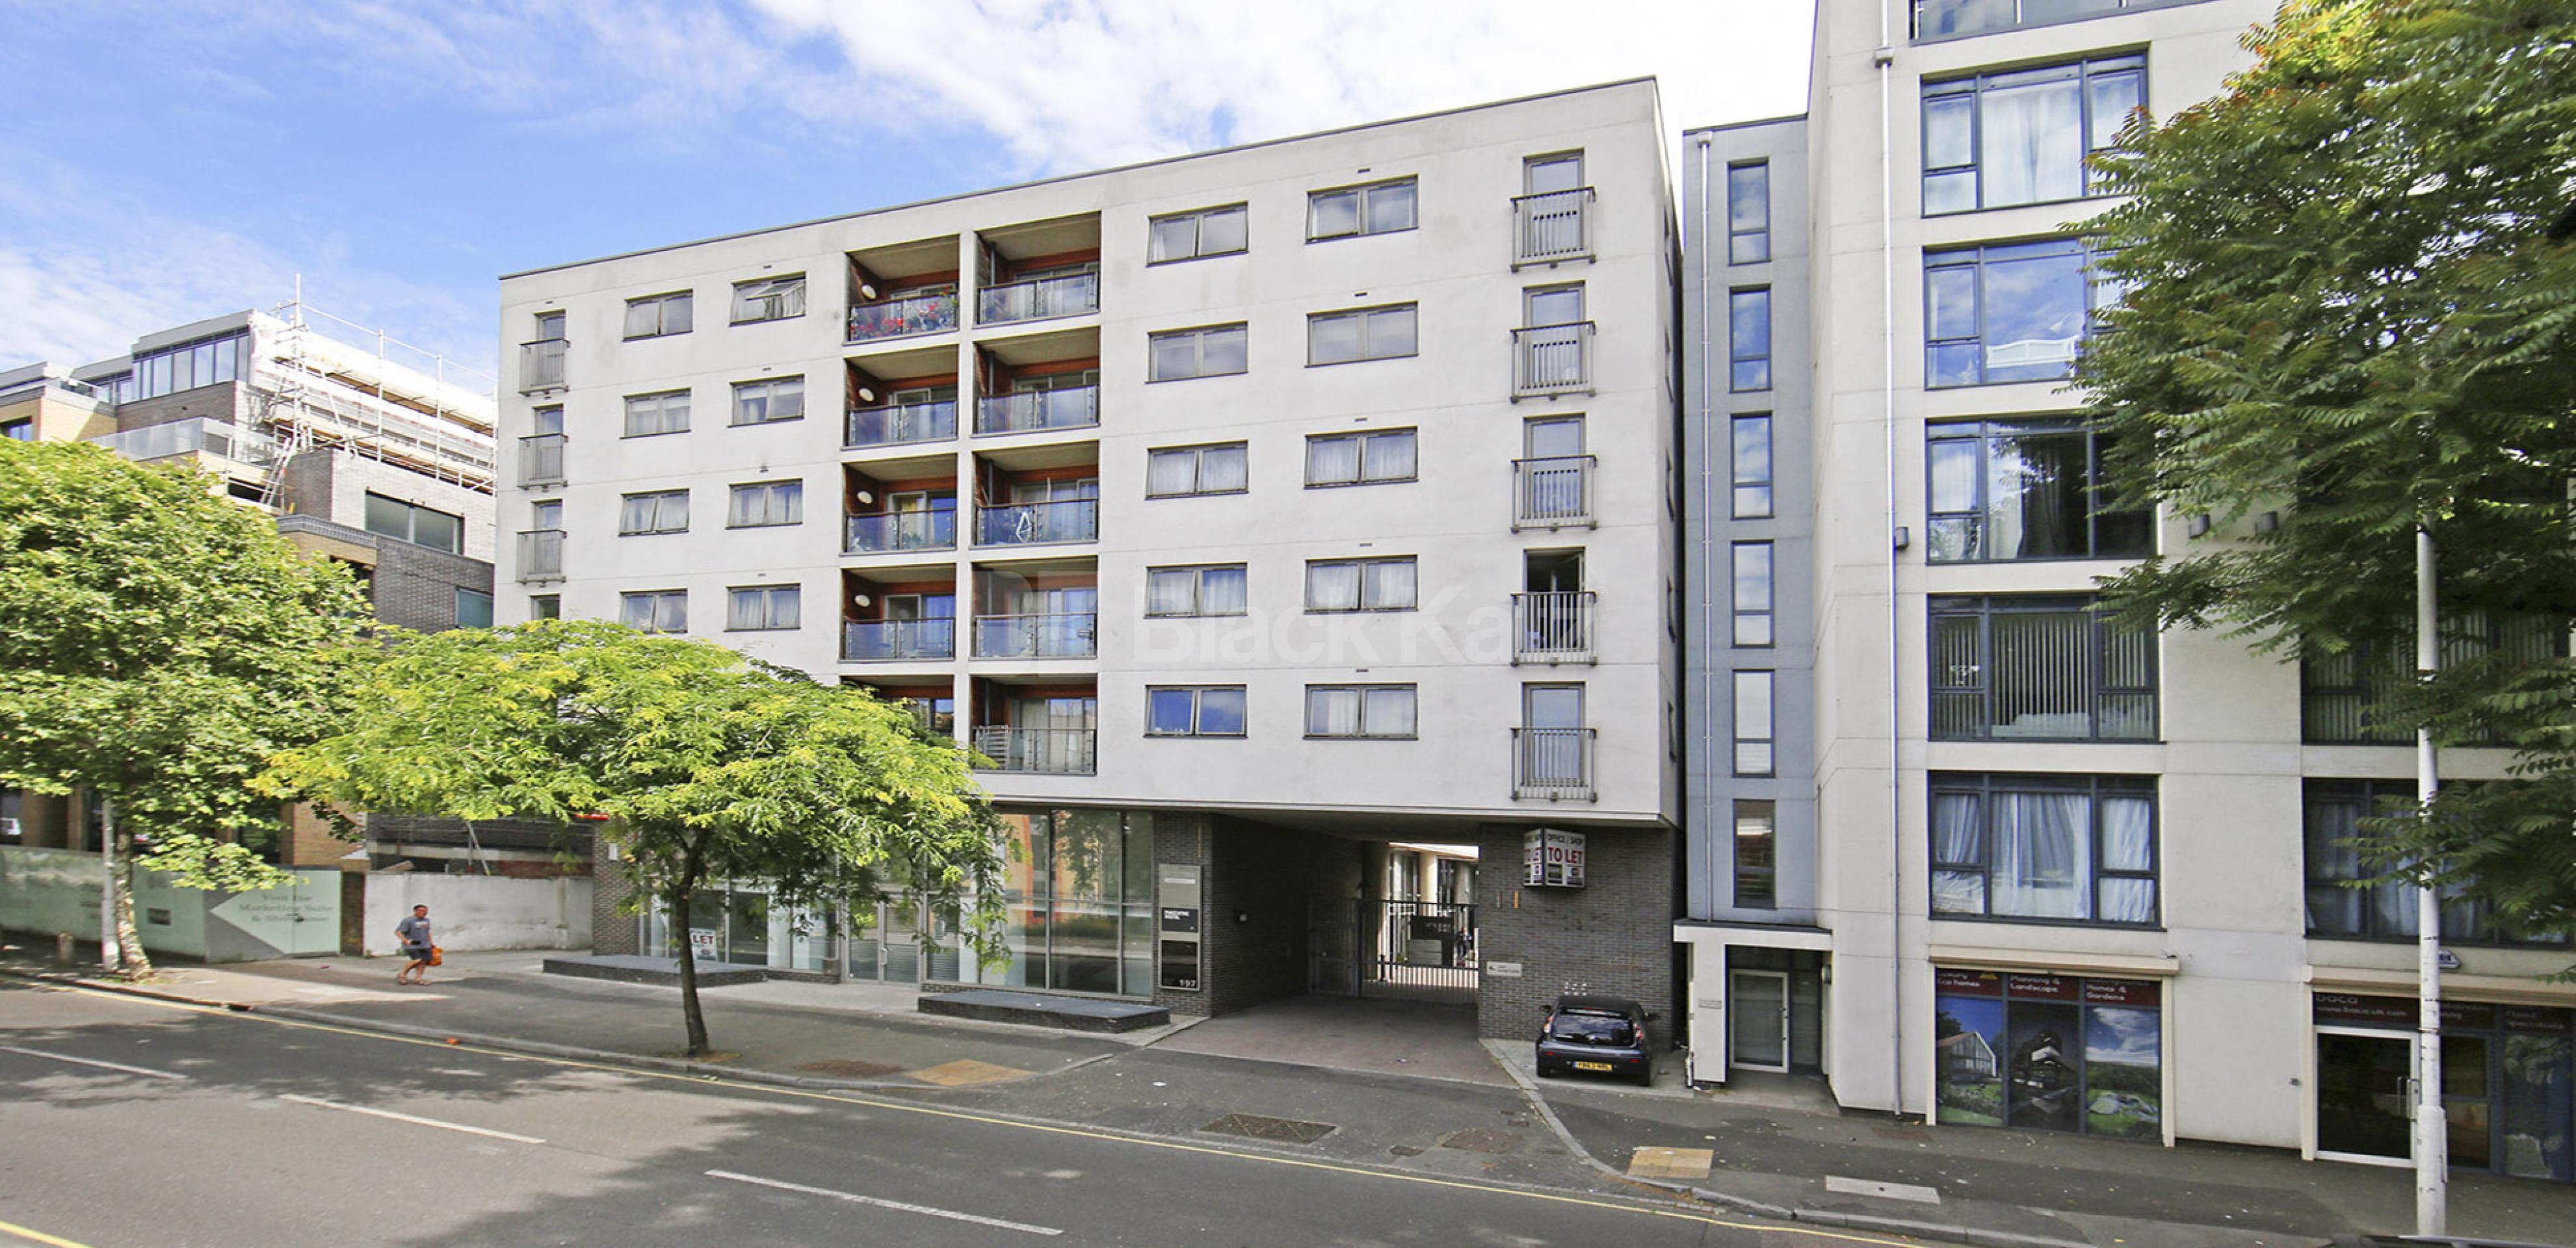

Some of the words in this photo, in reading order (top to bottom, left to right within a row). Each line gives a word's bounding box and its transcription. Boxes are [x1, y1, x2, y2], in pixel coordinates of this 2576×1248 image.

[1547, 846, 1562, 863] TO
[1565, 849, 1583, 864] LET
[692, 934, 714, 944] LET
[1179, 978, 1196, 987] 197
